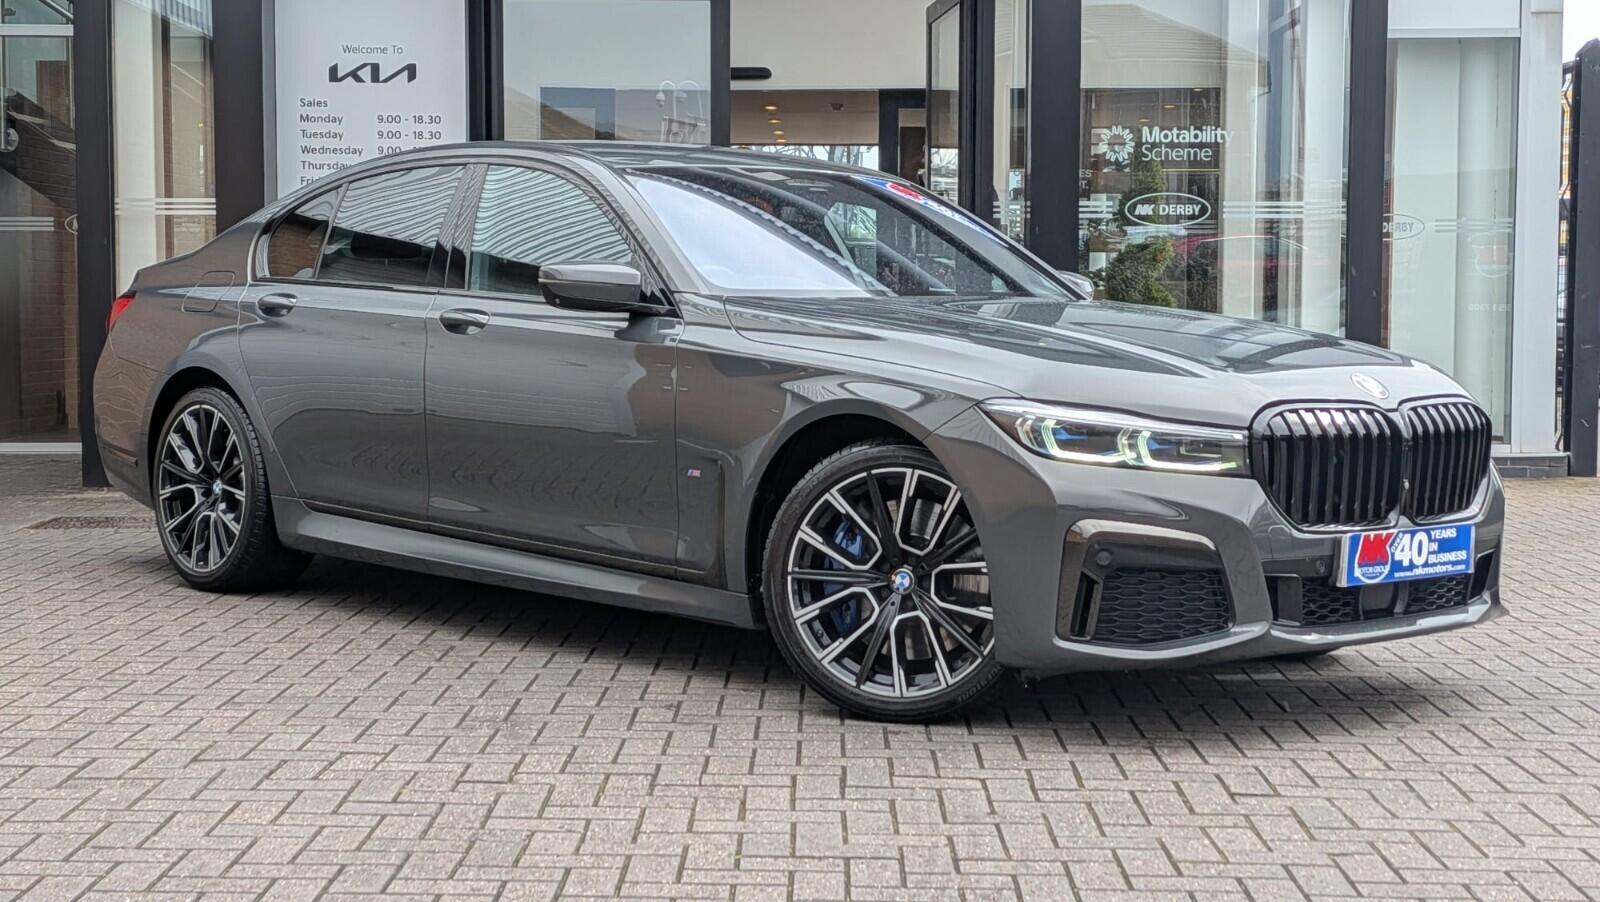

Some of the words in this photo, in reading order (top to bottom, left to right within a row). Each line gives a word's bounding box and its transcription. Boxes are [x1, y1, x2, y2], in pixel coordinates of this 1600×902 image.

[341, 44, 388, 55] Welcome
[392, 45, 404, 55] To
[328, 62, 417, 84] KIA
[299, 98, 328, 108] Sales
[299, 114, 343, 126] Monday
[377, 115, 402, 124] 9.00
[412, 115, 442, 125] 18.30
[299, 129, 344, 141] Tuesday
[377, 131, 402, 140] 9.00
[412, 131, 442, 140] 18.30
[1141, 126, 1233, 147] Motability
[300, 145, 363, 157] Wednesday
[1141, 144, 1212, 161] Scheme
[300, 176, 321, 186] Fri
[1159, 204, 1202, 216] DERBY
[1382, 222, 1415, 233] DERBY
[1431, 527, 1457, 539] YEARS
[1395, 531, 1428, 567] 40
[1428, 541, 1438, 552] IN
[1428, 550, 1467, 564] BUSINESS
